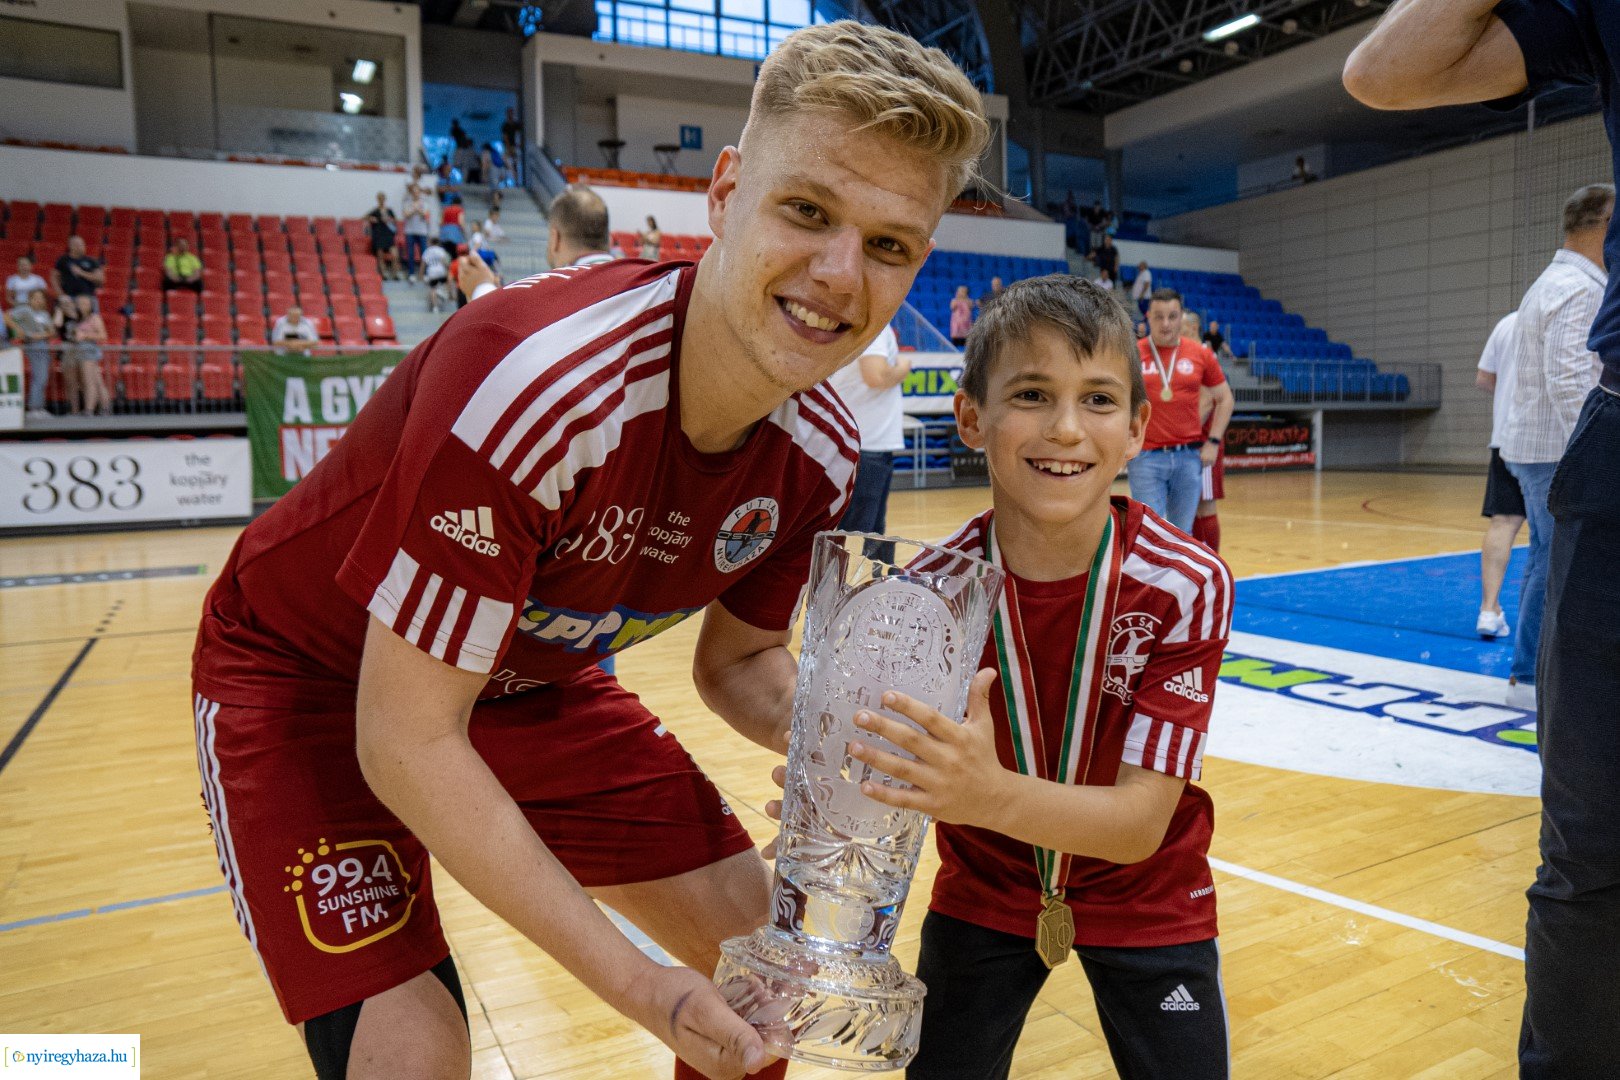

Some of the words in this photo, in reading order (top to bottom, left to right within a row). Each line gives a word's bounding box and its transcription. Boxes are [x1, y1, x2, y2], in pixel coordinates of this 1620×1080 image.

[902, 369, 959, 395] MIX
[283, 377, 313, 423] A
[320, 367, 395, 424] GY
[184, 453, 211, 468] the
[22, 455, 144, 513] 383
[176, 491, 223, 507] water
[667, 510, 692, 527] the
[430, 515, 501, 558] adidas
[1112, 616, 1155, 633] UTSA
[1163, 681, 1209, 703] adidas
[311, 854, 393, 897] 99.4
[317, 884, 400, 915] SUNSHINE
[341, 903, 389, 934] FM
[1160, 1000, 1200, 1011] adidas
